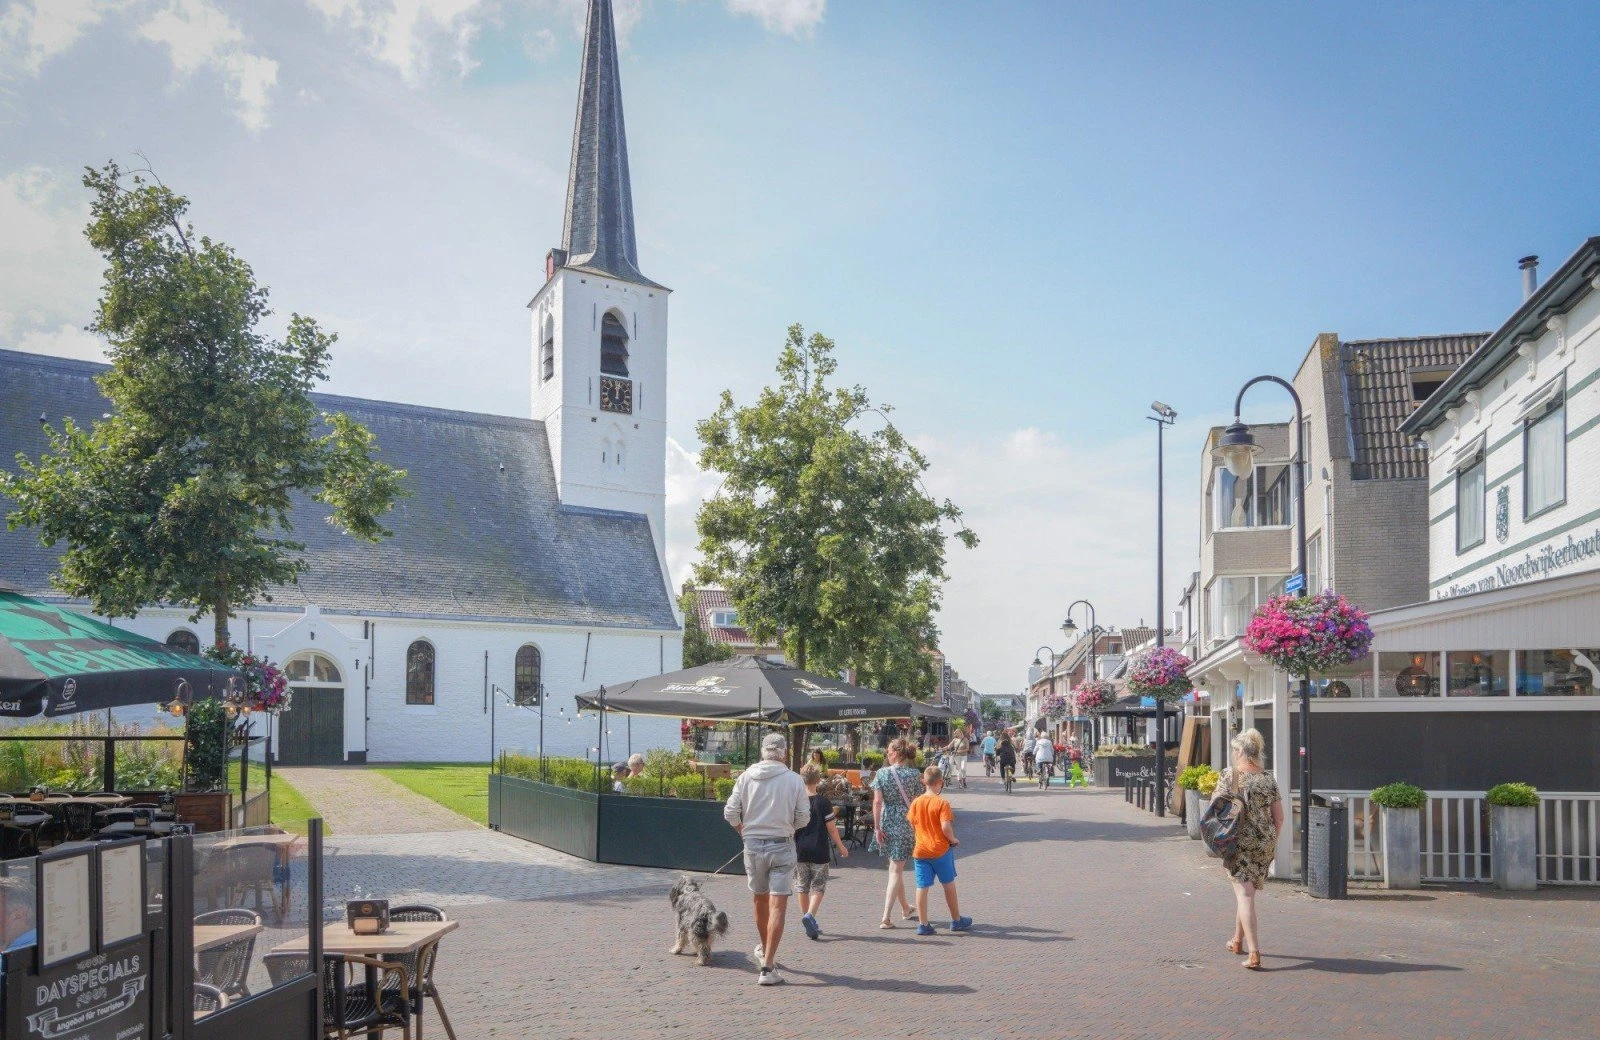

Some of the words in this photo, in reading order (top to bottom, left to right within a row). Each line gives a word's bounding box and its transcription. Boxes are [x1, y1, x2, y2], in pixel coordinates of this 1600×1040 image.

[1478, 575, 1495, 592] van
[1496, 528, 1600, 588] Noordwijkerhout
[36, 954, 140, 1006] DAYSPECIALS
[56, 1014, 85, 1032] Angebot
[97, 1000, 125, 1016] Touristen
